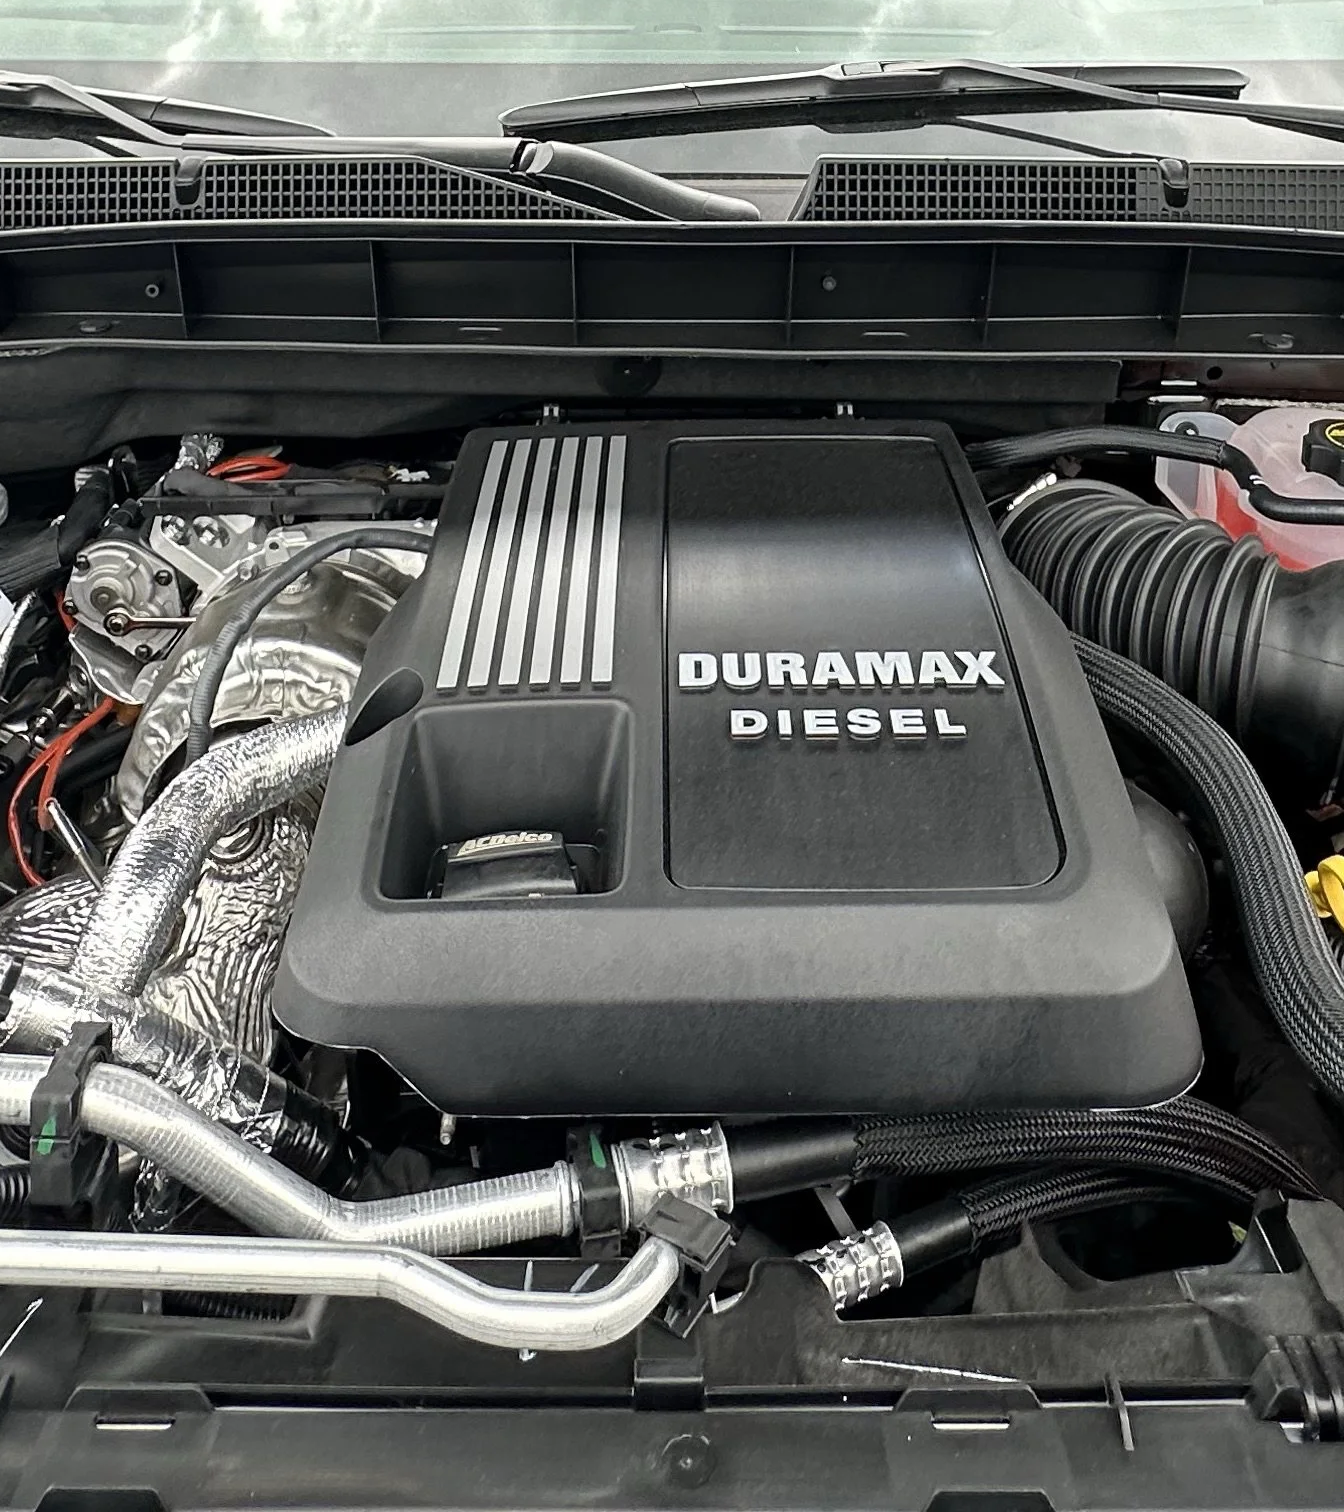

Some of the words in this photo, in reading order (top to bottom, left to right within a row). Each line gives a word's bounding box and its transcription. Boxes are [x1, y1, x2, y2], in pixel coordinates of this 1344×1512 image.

[677, 650, 1006, 689] DURAMAX
[730, 708, 968, 739] DIESEL
[457, 832, 553, 856] ACDelco
